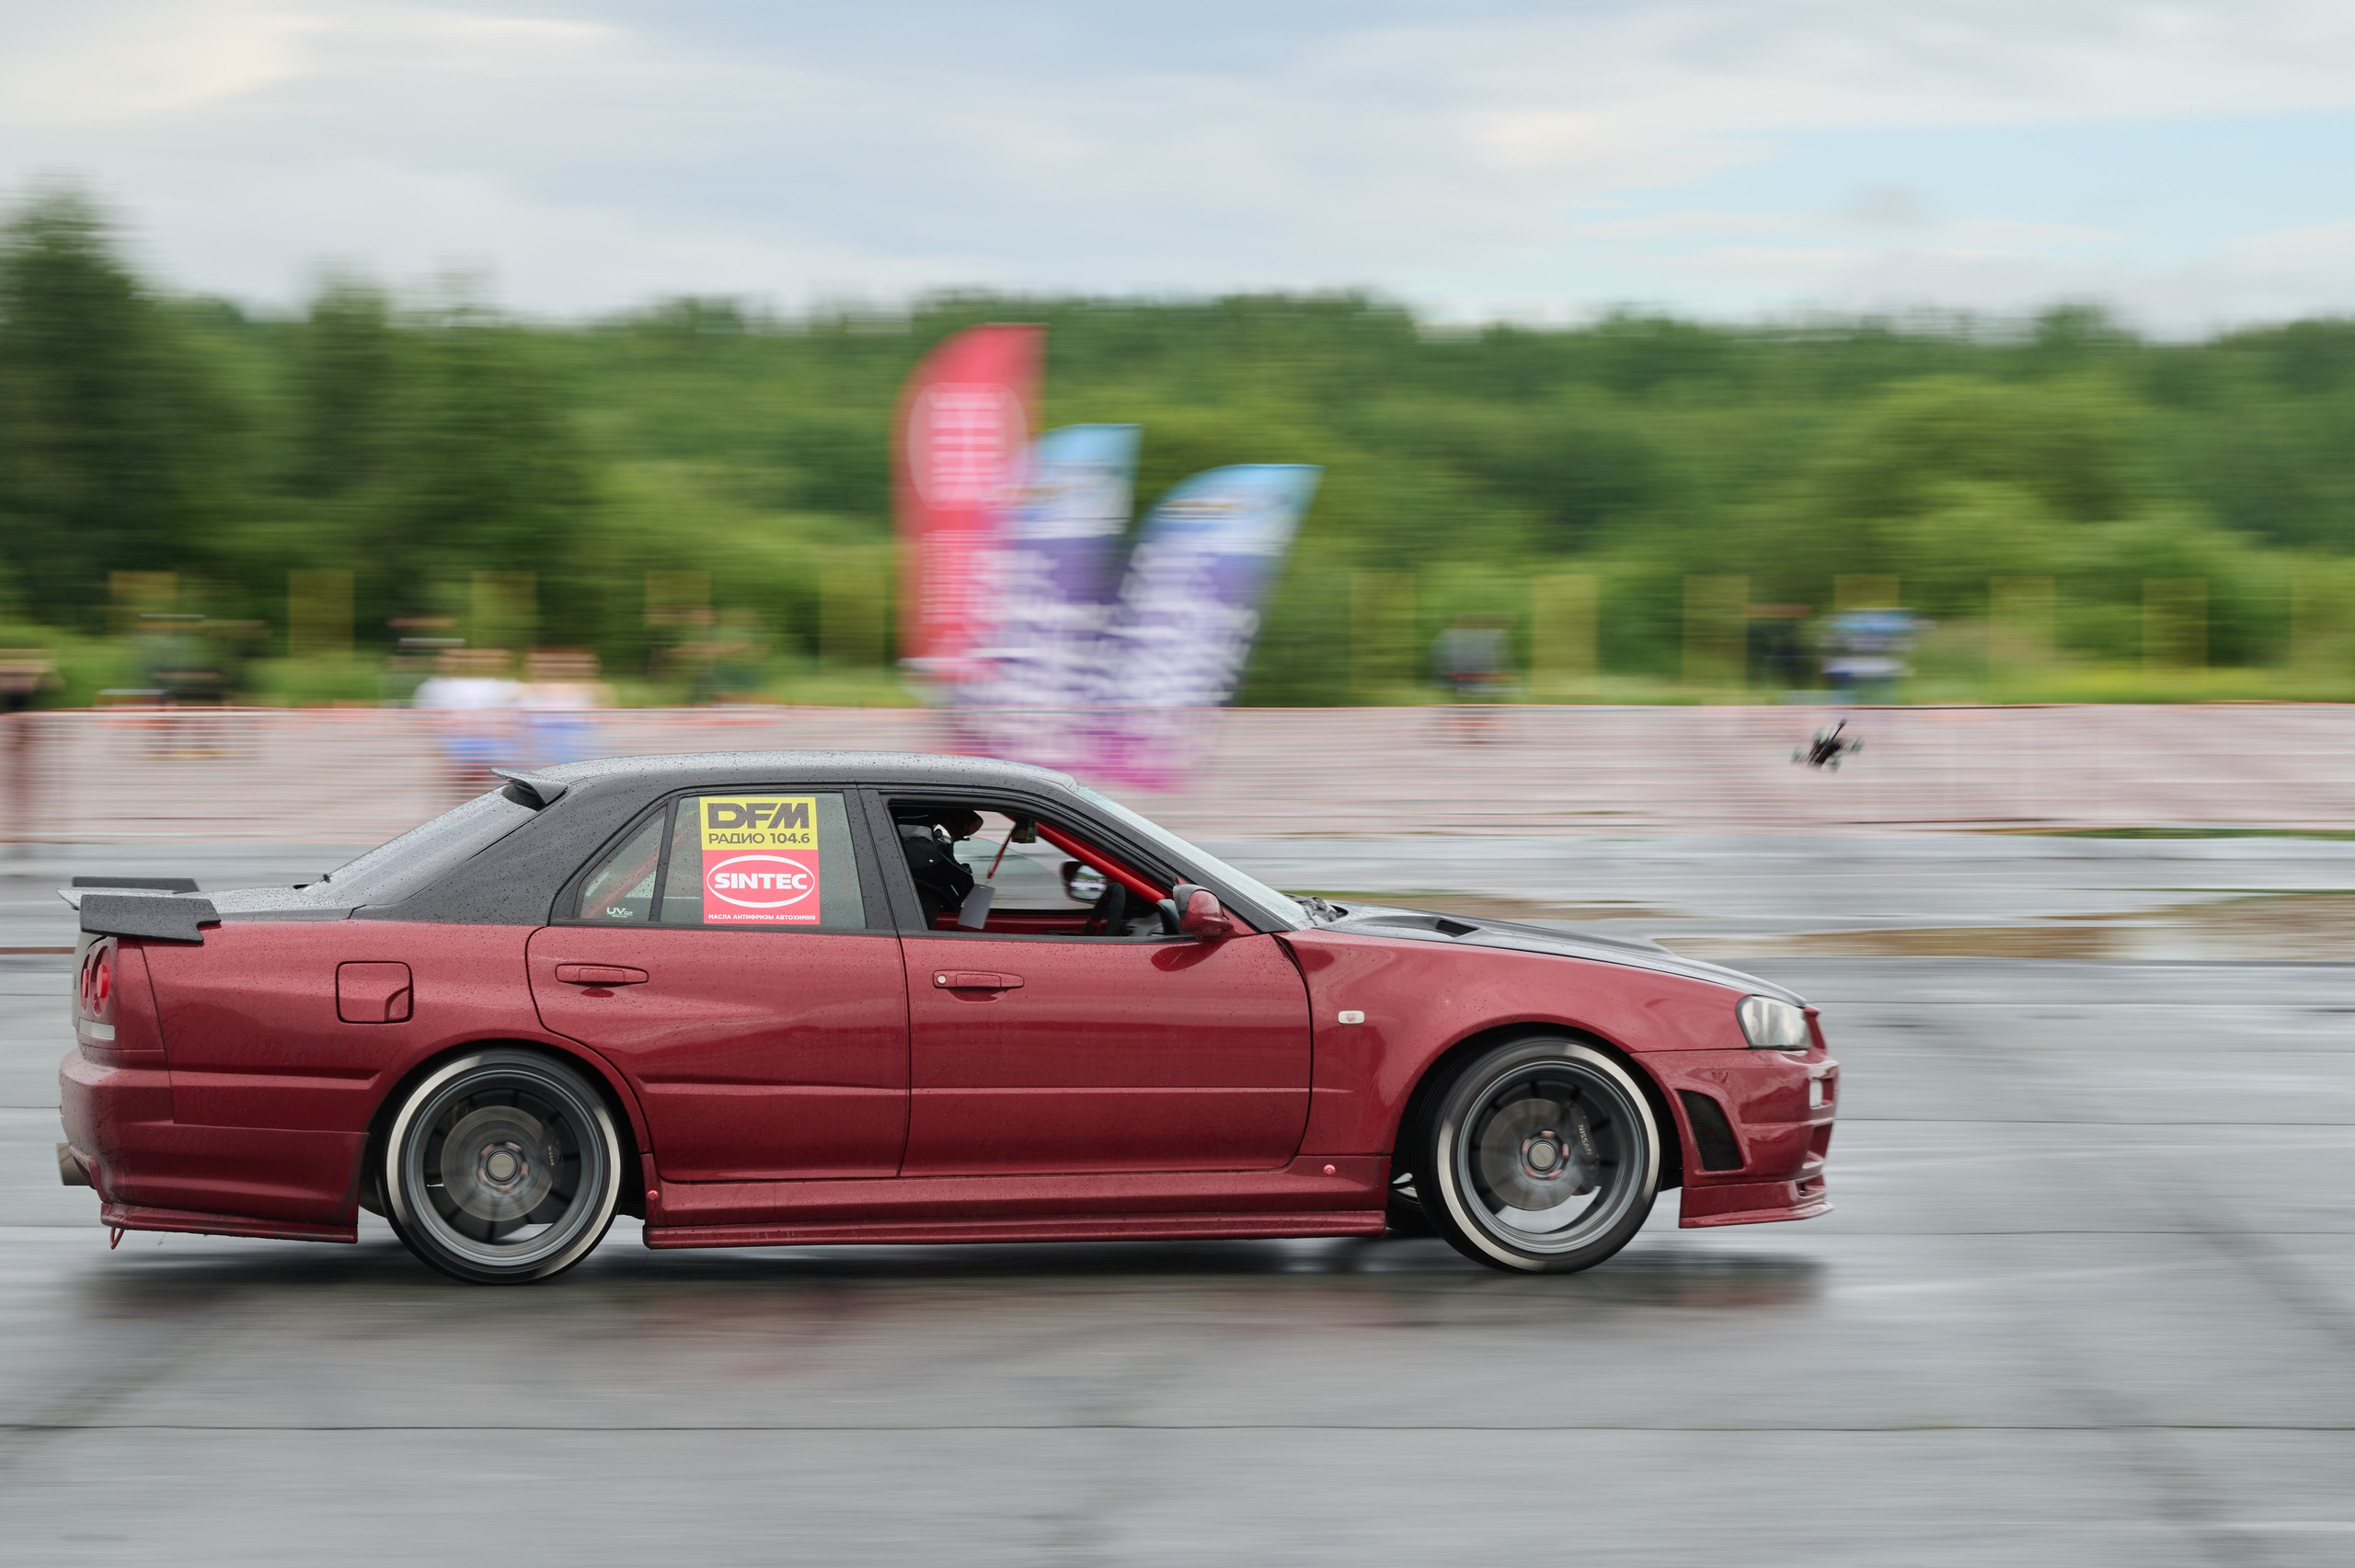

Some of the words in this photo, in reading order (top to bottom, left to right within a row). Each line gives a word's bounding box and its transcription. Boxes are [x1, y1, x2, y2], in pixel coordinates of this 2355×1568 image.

[707, 803, 810, 829] DFM
[708, 832, 765, 844] РАДИО
[770, 832, 810, 844] 104.6
[714, 873, 808, 890] SINTEC
[606, 907, 626, 915] UV
[1578, 1124, 1592, 1155] NISSAN
